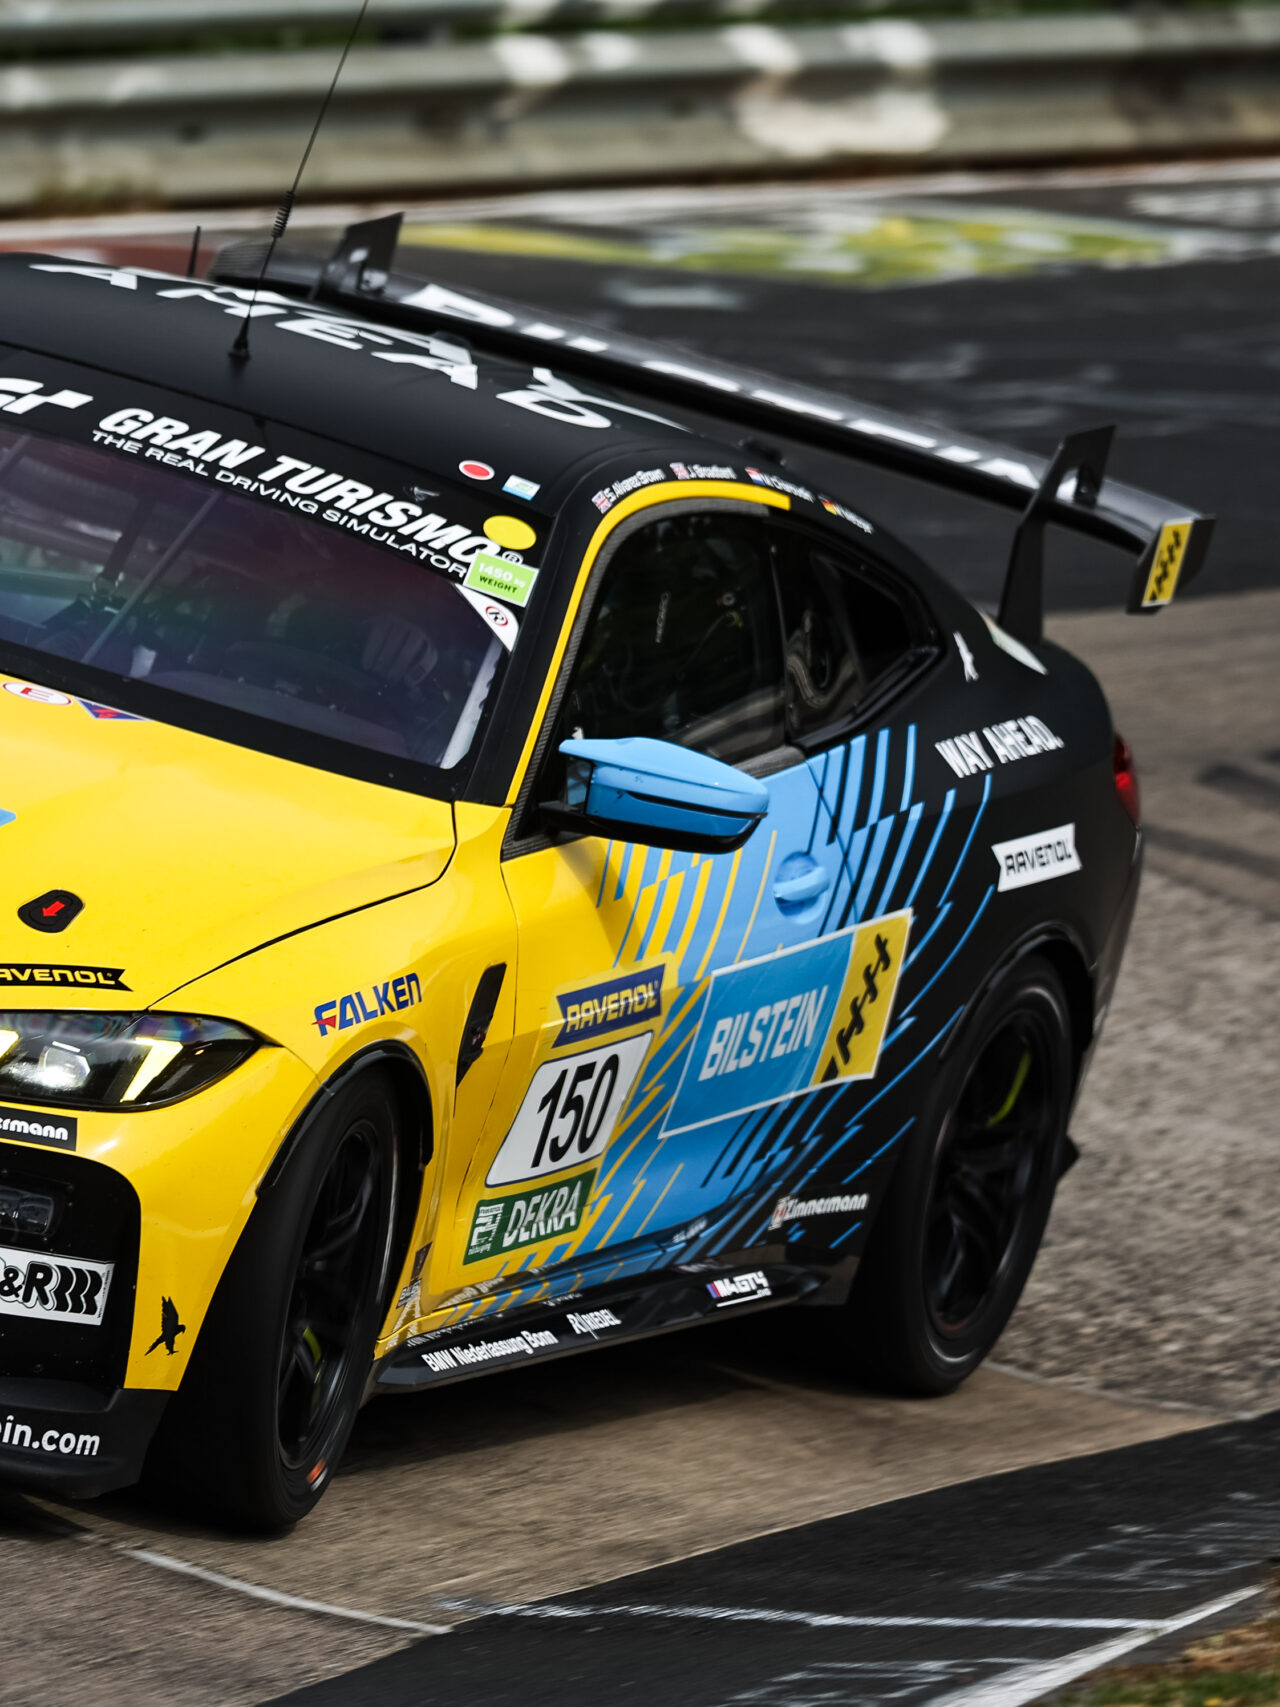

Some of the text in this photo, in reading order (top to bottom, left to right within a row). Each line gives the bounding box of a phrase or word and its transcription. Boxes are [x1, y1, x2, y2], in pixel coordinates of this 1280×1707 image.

[92, 429, 469, 579] THE REAL DRIVING SIMULATOR
[98, 407, 502, 563] GRAN TURISMO
[479, 574, 518, 594] WEIGHT
[934, 730, 994, 779] WAY
[1004, 838, 1073, 877] RAVENOL
[311, 972, 423, 1037] FALKEN
[566, 980, 658, 1033] RAVENOL
[698, 984, 830, 1082] BILSTEIN
[530, 1053, 620, 1169] 150
[502, 1180, 583, 1248] DEKRA
[784, 1193, 869, 1222] Zimmermann
[421, 1330, 560, 1373] BMW Niederlassung Bonn
